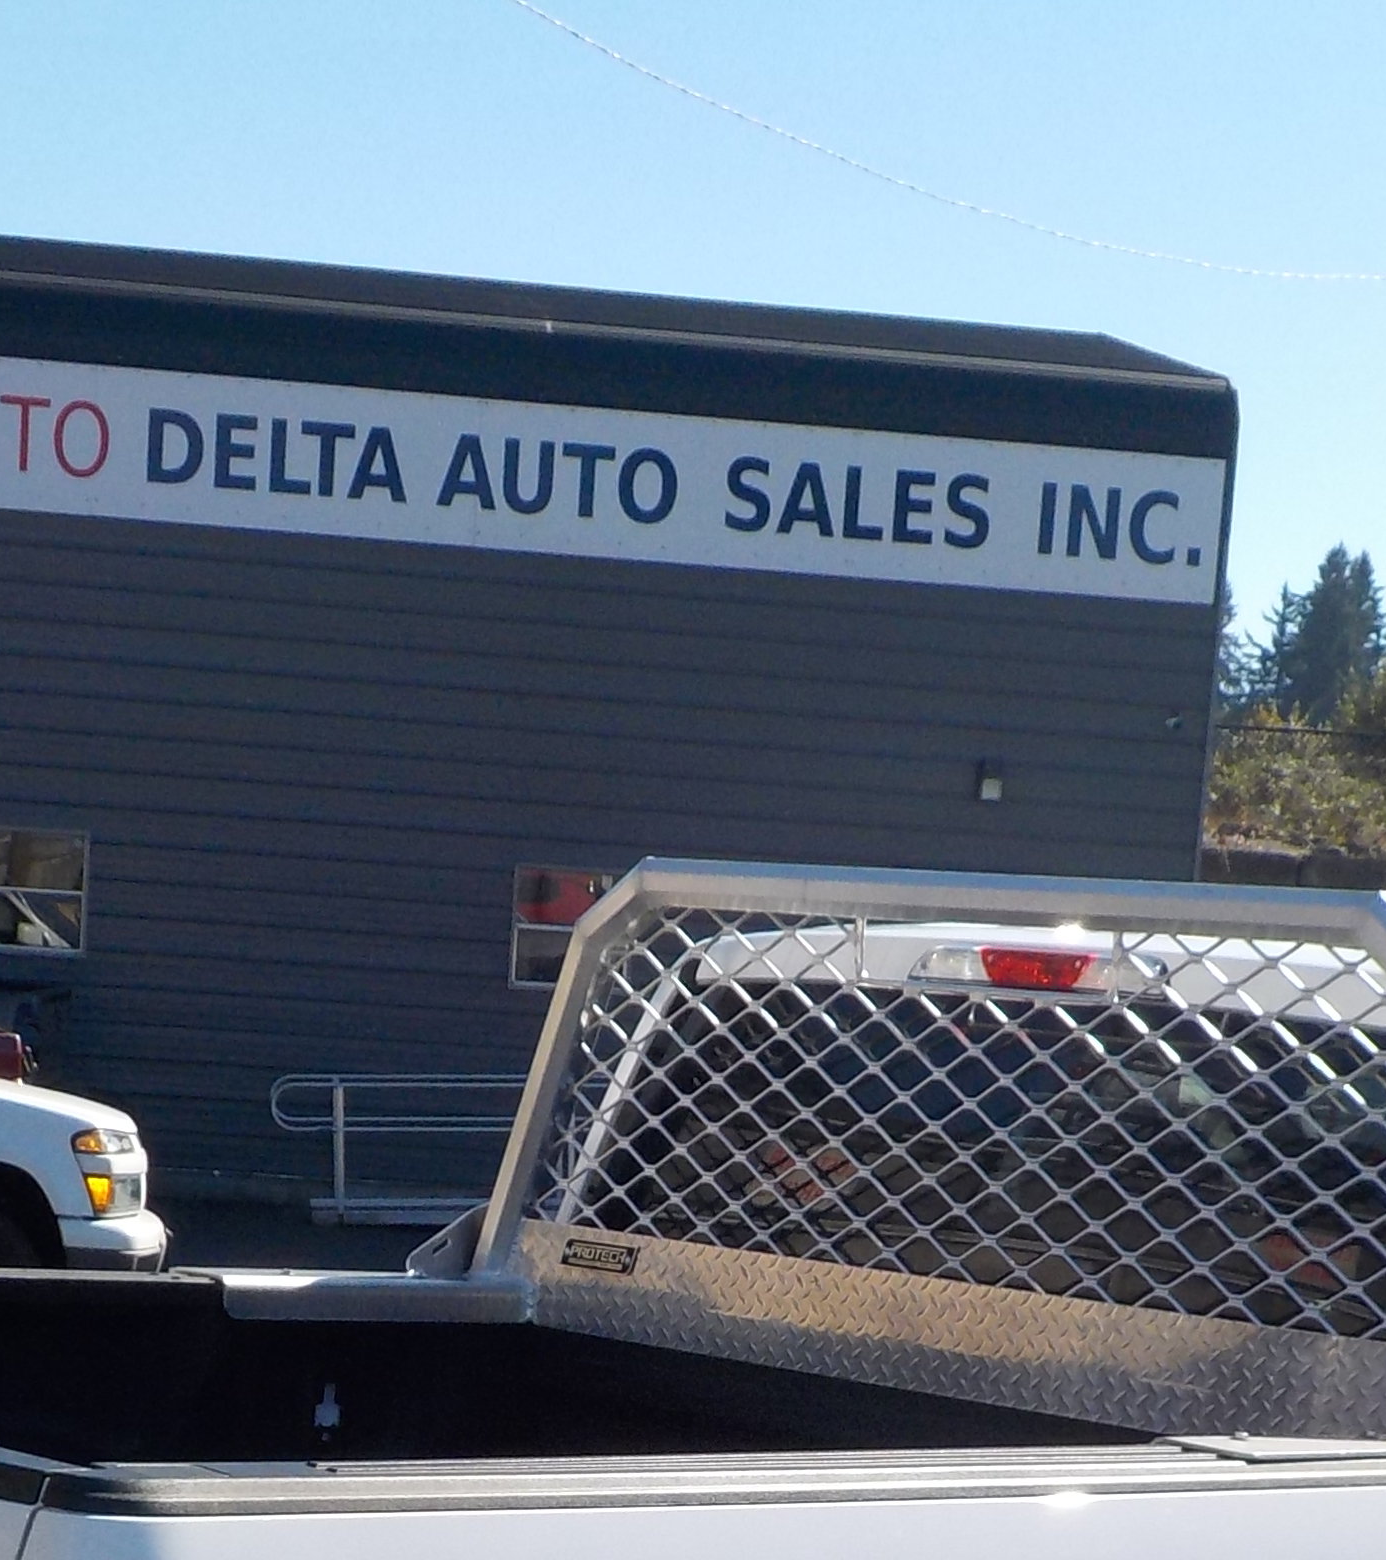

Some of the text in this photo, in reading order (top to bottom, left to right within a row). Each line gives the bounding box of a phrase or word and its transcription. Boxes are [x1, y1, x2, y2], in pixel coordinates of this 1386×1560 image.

[0, 393, 110, 480] TO
[145, 407, 407, 504] DELTA
[436, 433, 679, 525] AUTO
[723, 455, 991, 550] SALES
[1037, 480, 1203, 568] INC.
